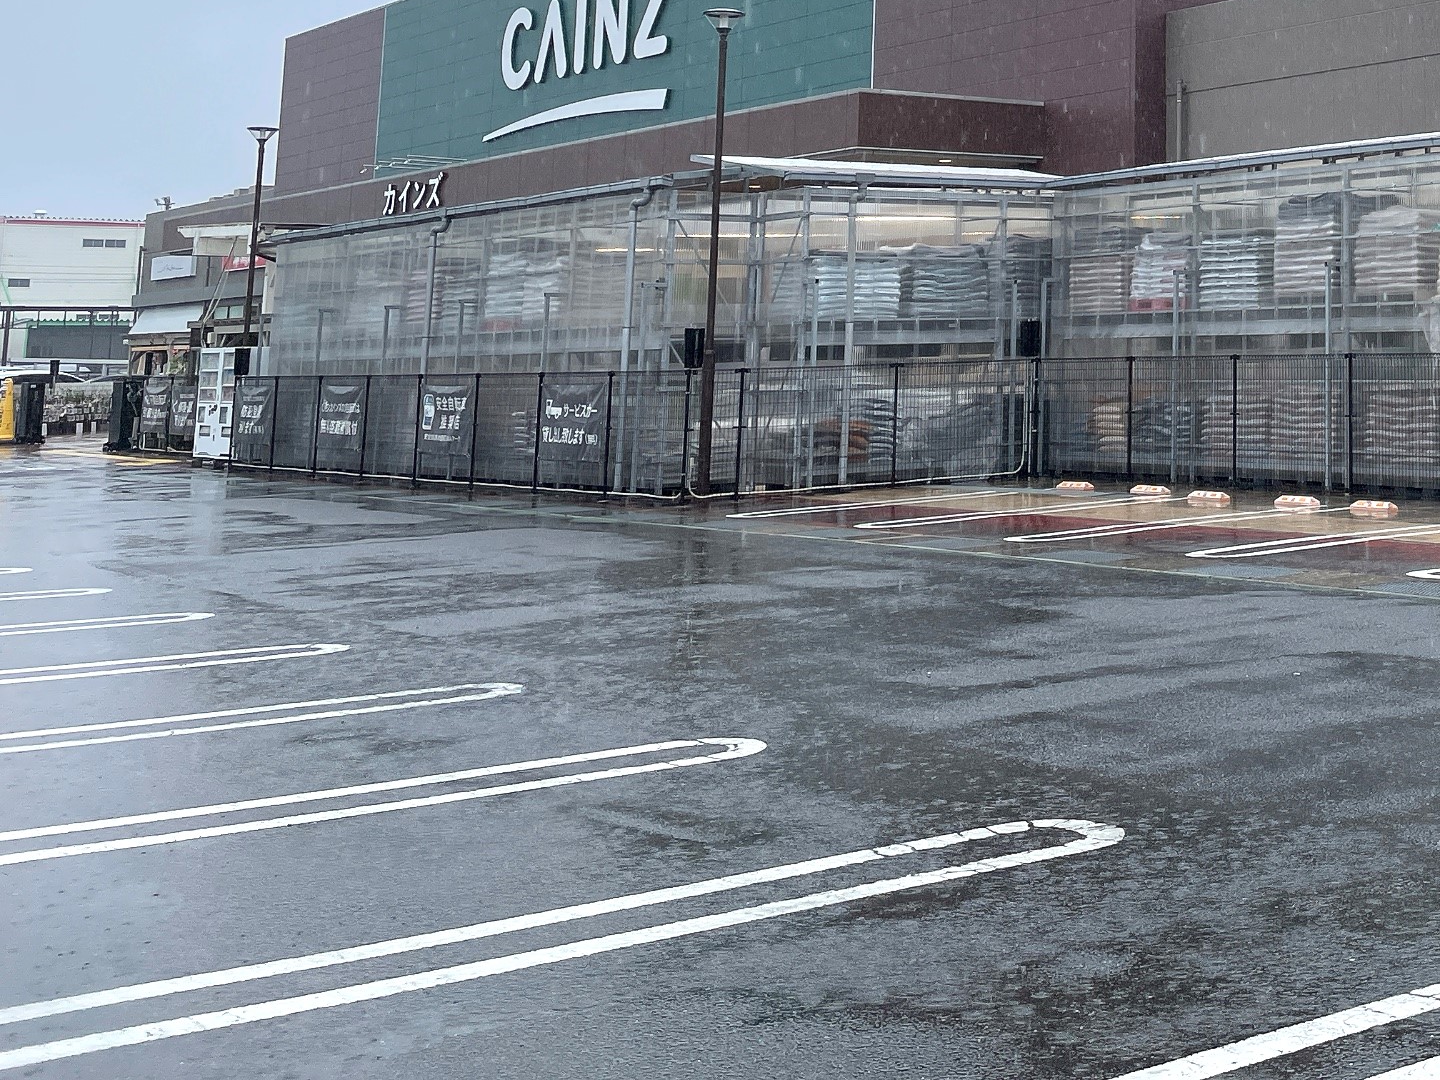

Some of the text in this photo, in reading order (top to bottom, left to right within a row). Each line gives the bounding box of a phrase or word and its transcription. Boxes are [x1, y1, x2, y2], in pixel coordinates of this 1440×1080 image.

[382, 171, 444, 216] カインズ
[563, 403, 598, 418] サービスカー
